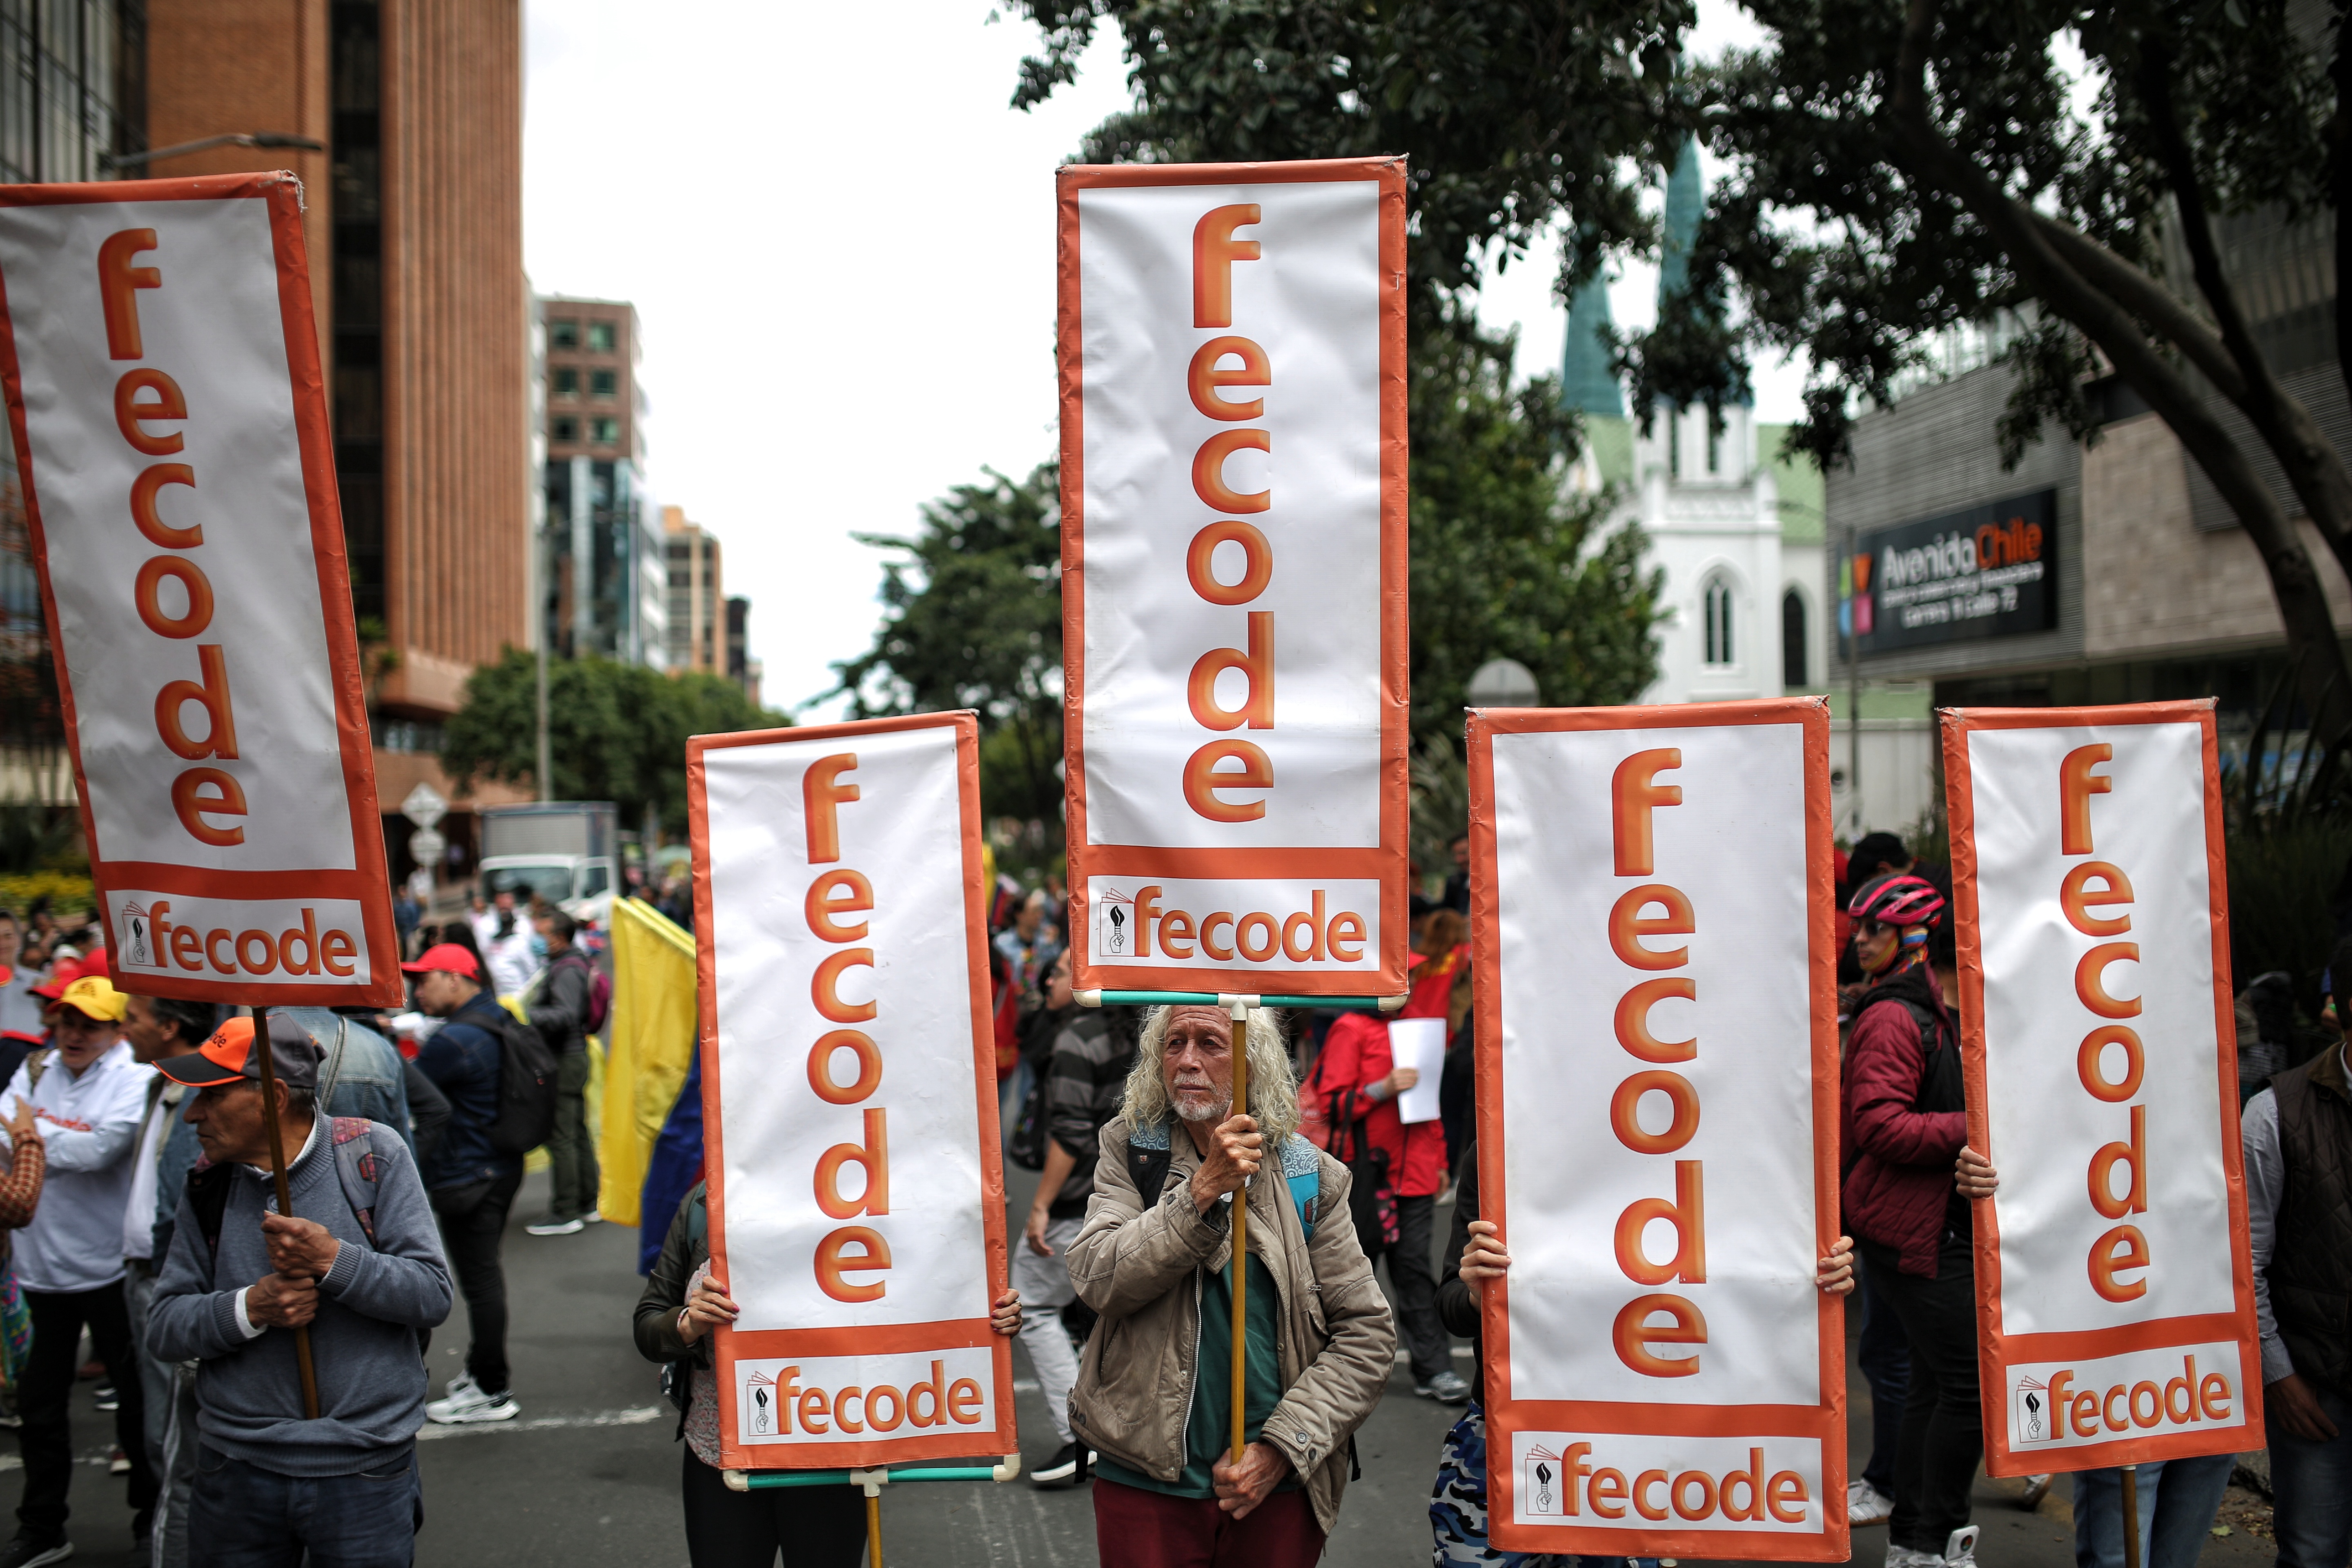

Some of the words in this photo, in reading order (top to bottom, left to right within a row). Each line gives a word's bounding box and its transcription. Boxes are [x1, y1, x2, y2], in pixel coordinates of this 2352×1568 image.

[99, 228, 247, 846] fecode
[1183, 203, 1274, 823] fecode
[149, 900, 358, 976] fecode
[803, 752, 892, 1303] fecode
[1134, 885, 1367, 962] fecode
[1608, 748, 1708, 1378] fecode
[2060, 743, 2150, 1303] fecode
[776, 1360, 984, 1434] fecode
[1560, 1441, 1809, 1523] fecode
[2049, 1355, 2232, 1439] fecode
